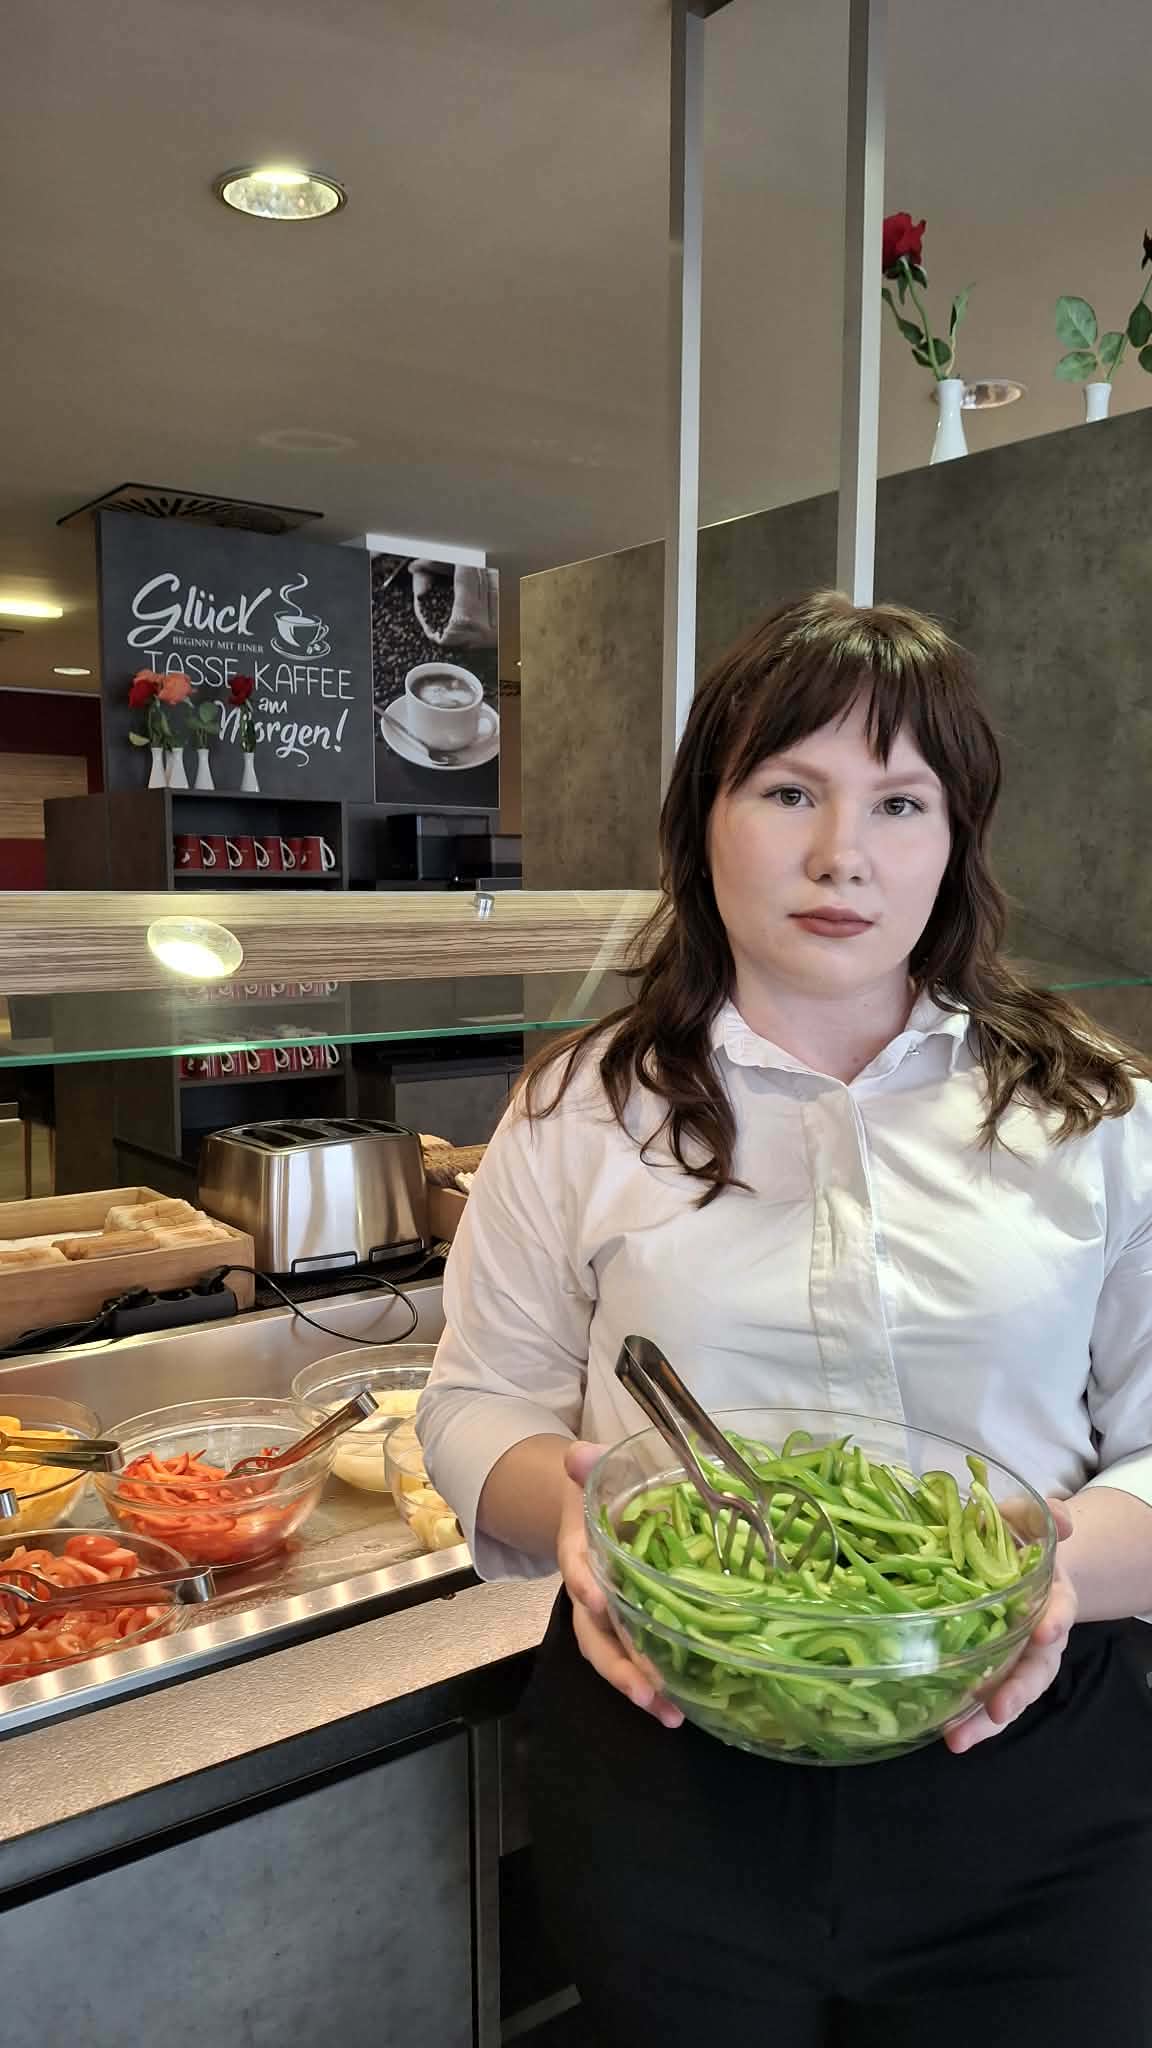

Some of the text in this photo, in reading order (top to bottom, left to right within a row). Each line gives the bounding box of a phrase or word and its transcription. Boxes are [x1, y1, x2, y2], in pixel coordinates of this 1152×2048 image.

[127, 572, 273, 648] Glück
[172, 635, 264, 653] BEGINNT MIT EINER
[143, 650, 356, 700] TASSE KAFFEE
[258, 697, 288, 714] am
